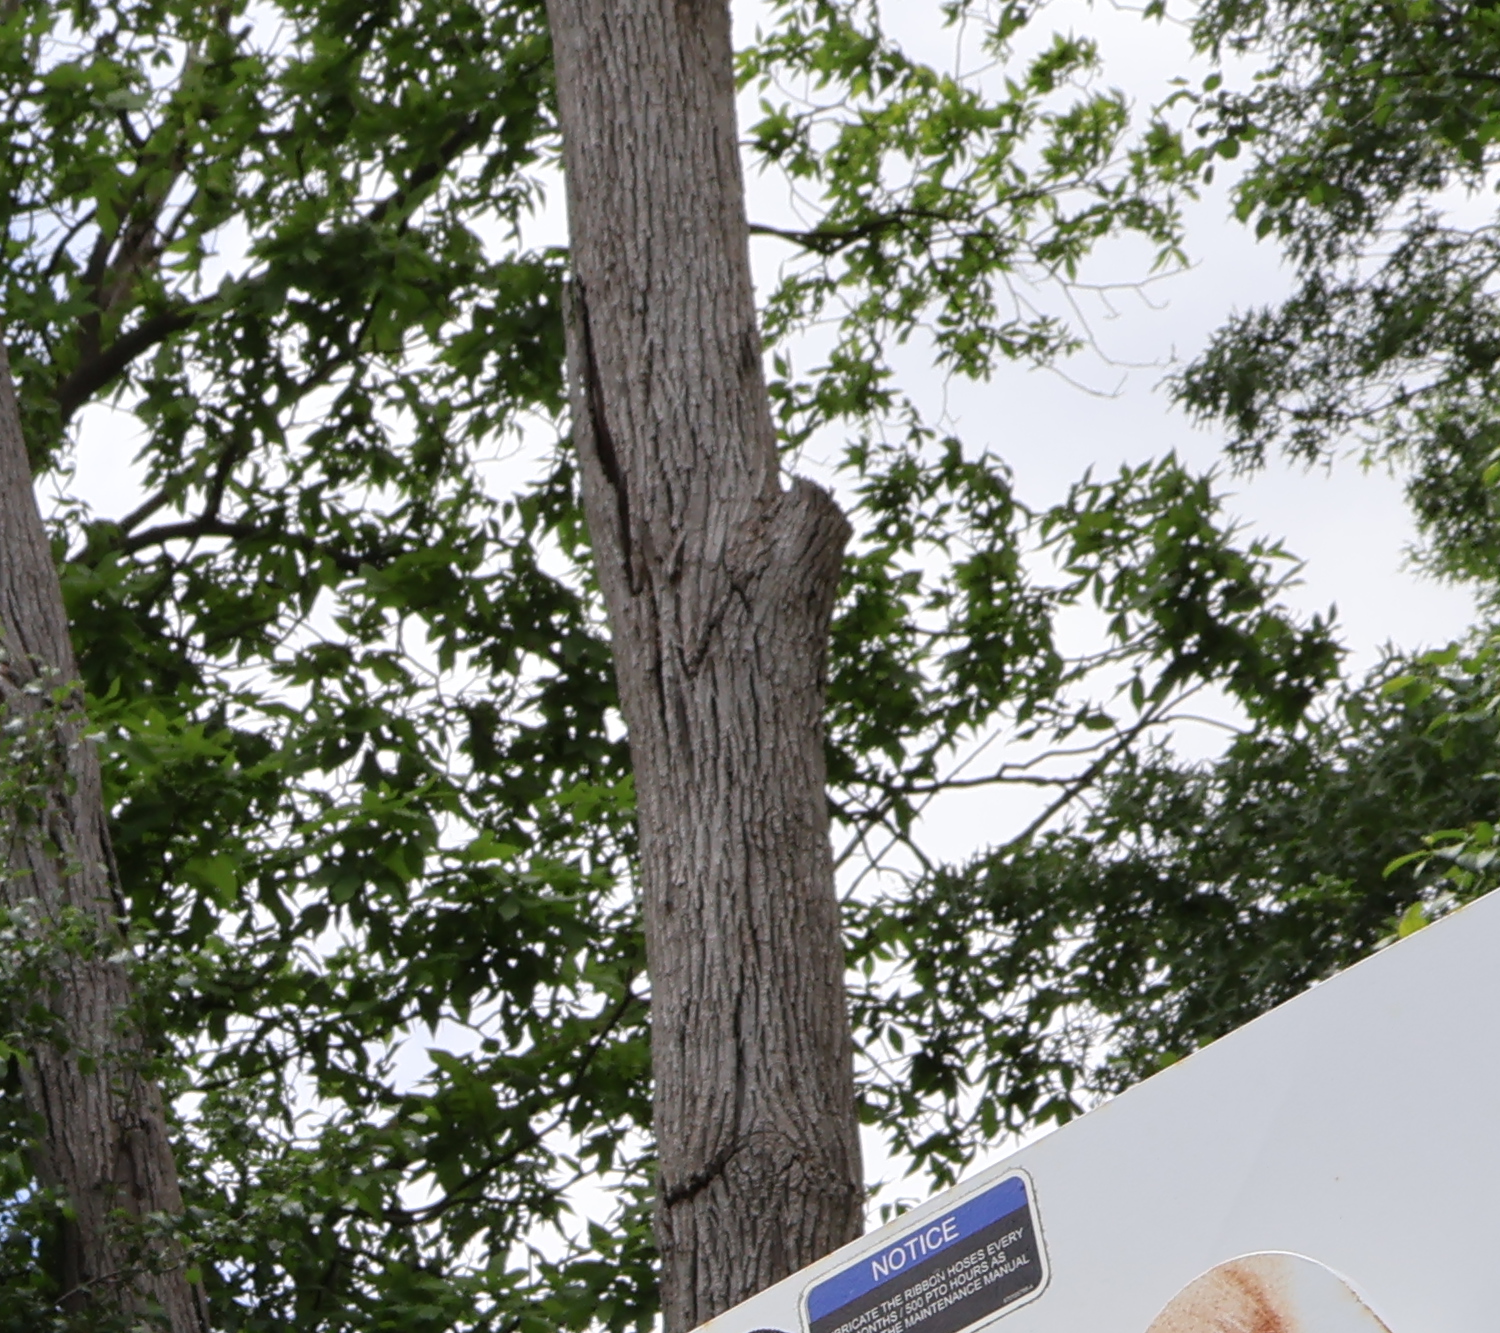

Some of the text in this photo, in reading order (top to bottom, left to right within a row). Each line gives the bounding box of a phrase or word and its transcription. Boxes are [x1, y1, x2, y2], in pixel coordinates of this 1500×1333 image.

[871, 1217, 960, 1281] NOTICE
[881, 1294, 904, 1312] THE
[904, 1269, 946, 1301] RIBBON
[947, 1248, 985, 1280] HOSES
[987, 1227, 1024, 1258] EVERY
[905, 1297, 924, 1314] 500
[925, 1283, 948, 1302] PTO
[950, 1265, 989, 1291] HOURS
[991, 1253, 1006, 1271] AS
[904, 1284, 982, 1329] MAINTENANCE
[984, 1255, 1030, 1287] MANUAL
